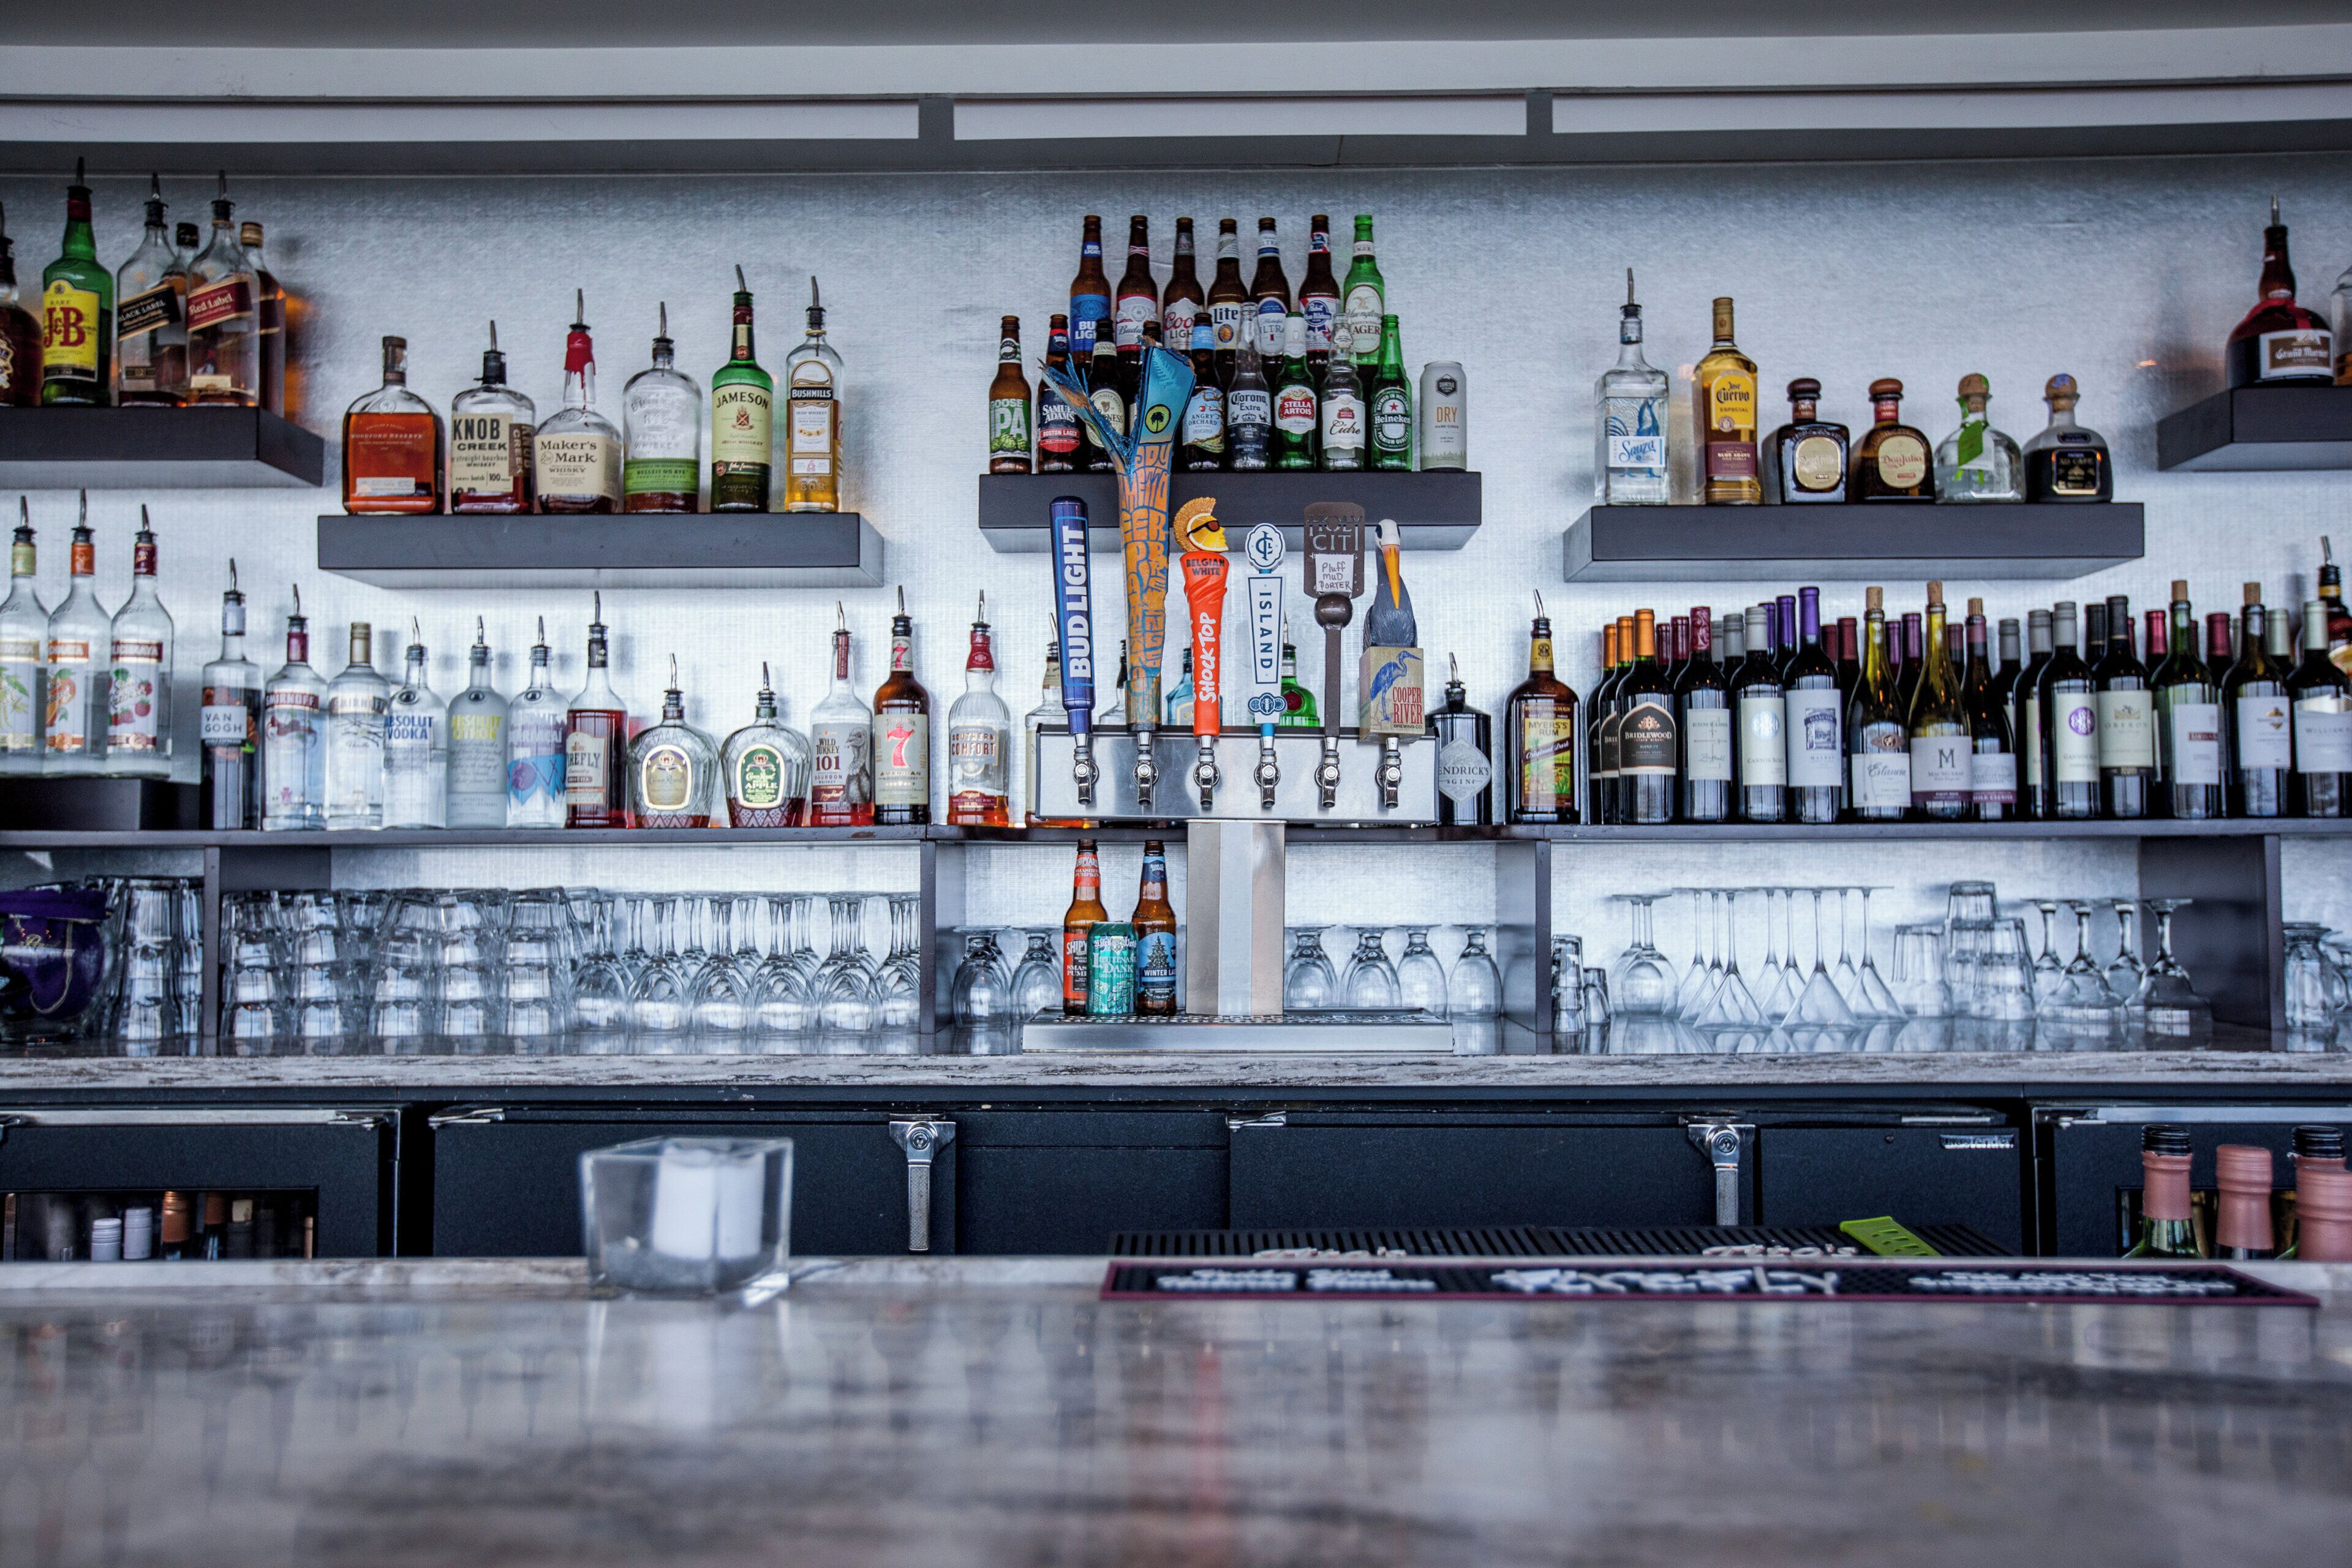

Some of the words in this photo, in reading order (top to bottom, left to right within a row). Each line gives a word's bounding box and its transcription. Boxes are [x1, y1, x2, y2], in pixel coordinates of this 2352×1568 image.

[189, 303, 207, 315] Red
[1164, 311, 1194, 331] Coo
[1213, 307, 1238, 325] Lite
[43, 306, 86, 348] J&B
[1079, 321, 1096, 331] BU
[1074, 330, 1096, 340] LIG
[1169, 329, 1193, 339] LIGH
[791, 389, 832, 398] BUSHMILLS
[1231, 393, 1267, 406] Corona
[1716, 388, 1750, 404] Cuervo
[715, 391, 770, 410] JAMESON
[1240, 403, 1261, 412] Extra
[1045, 412, 1075, 424] ADAMS
[1436, 406, 1457, 423] DRY
[453, 418, 500, 440] KNOB
[1329, 420, 1361, 435] Cidre
[1377, 431, 1396, 444] PREMIUM
[457, 442, 507, 451] CREEK
[540, 440, 597, 451] Maker's
[1618, 440, 1656, 463] Sauza
[555, 452, 597, 464] Mark
[1307, 515, 1363, 535] HOLY
[1061, 525, 1088, 612] LIGHT
[1186, 558, 1224, 567] BELGIAN
[1322, 560, 1346, 573] Pluff
[1192, 567, 1220, 576] WHITE
[1318, 580, 1352, 591] PORTER
[1198, 612, 1216, 648] TOP
[1259, 591, 1273, 669] ISLAND
[1066, 614, 1091, 679] BUD
[1199, 647, 1217, 704] SHOCK
[265, 692, 315, 706] SMIRNOFF
[1392, 687, 1422, 704] COOPER
[205, 712, 232, 722] VAN
[1393, 703, 1423, 725] RIVER
[205, 723, 242, 733] GOGH
[384, 715, 434, 728] ABSOLUT
[451, 715, 501, 728] ABSOLUT
[1528, 721, 1569, 729] MYERS'S
[388, 728, 428, 739] VODKA
[952, 733, 996, 741] SOUTHERN
[1539, 728, 1559, 737] RUM
[1624, 731, 1672, 739] BRIDLEWOOD
[816, 745, 840, 755] TURKEY
[886, 727, 915, 768] 7
[951, 742, 997, 756] COMFORT
[1525, 746, 1553, 760] Original
[1553, 739, 1570, 752] Dark
[815, 755, 840, 771] 101
[1938, 747, 1955, 769] M
[1439, 766, 1490, 776] ENDRICK'S
[1066, 940, 1087, 955] SHIPY
[1103, 963, 1133, 974] DANK
